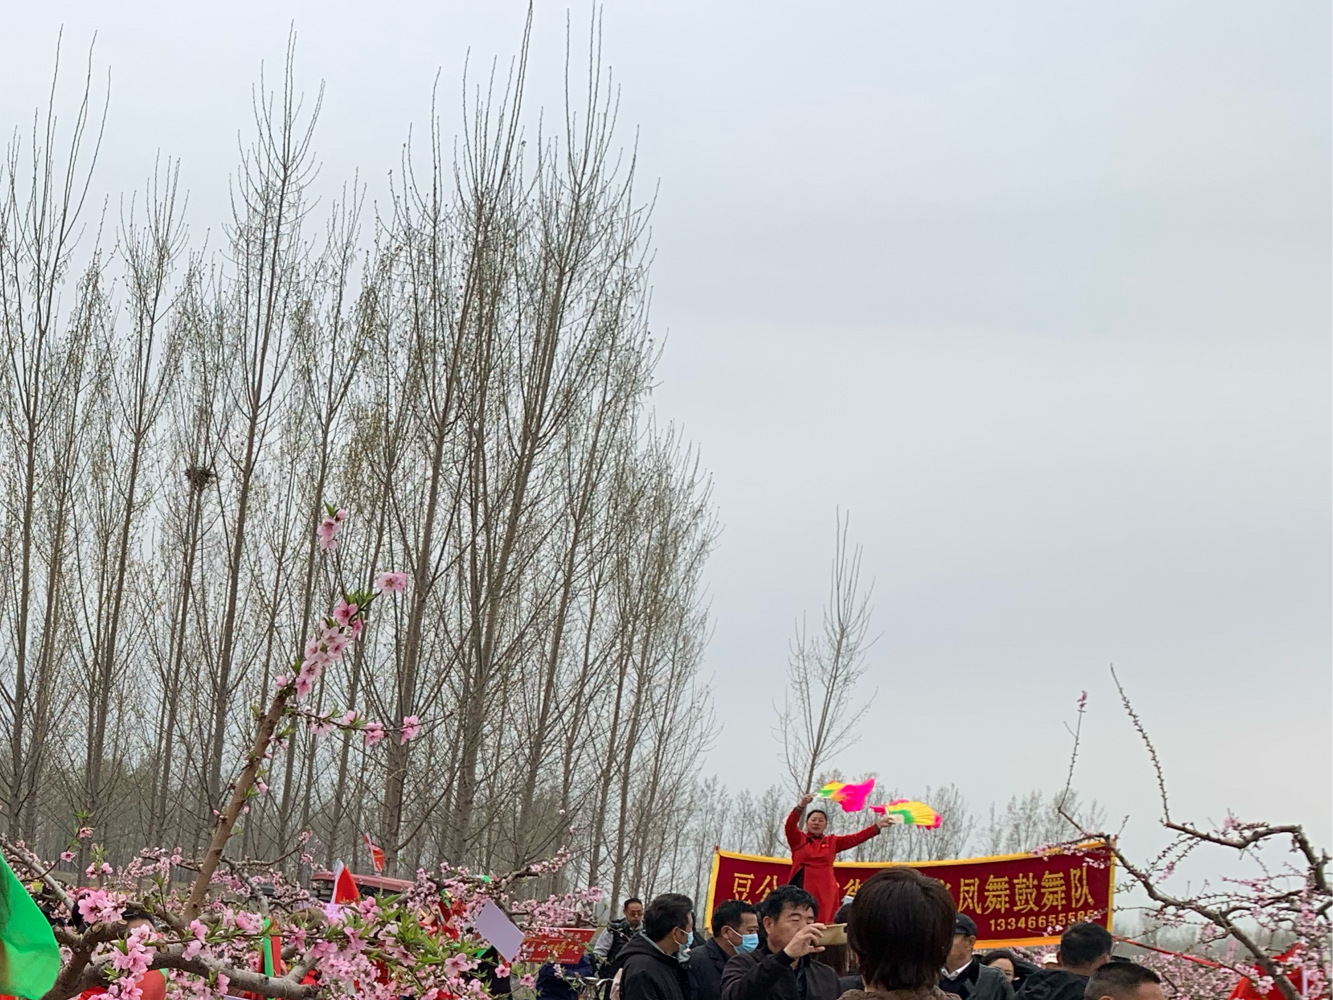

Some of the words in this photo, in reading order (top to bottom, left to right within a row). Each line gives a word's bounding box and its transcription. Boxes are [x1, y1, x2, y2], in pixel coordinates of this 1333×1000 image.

[958, 865, 1095, 915] 凤舞鼓舞队
